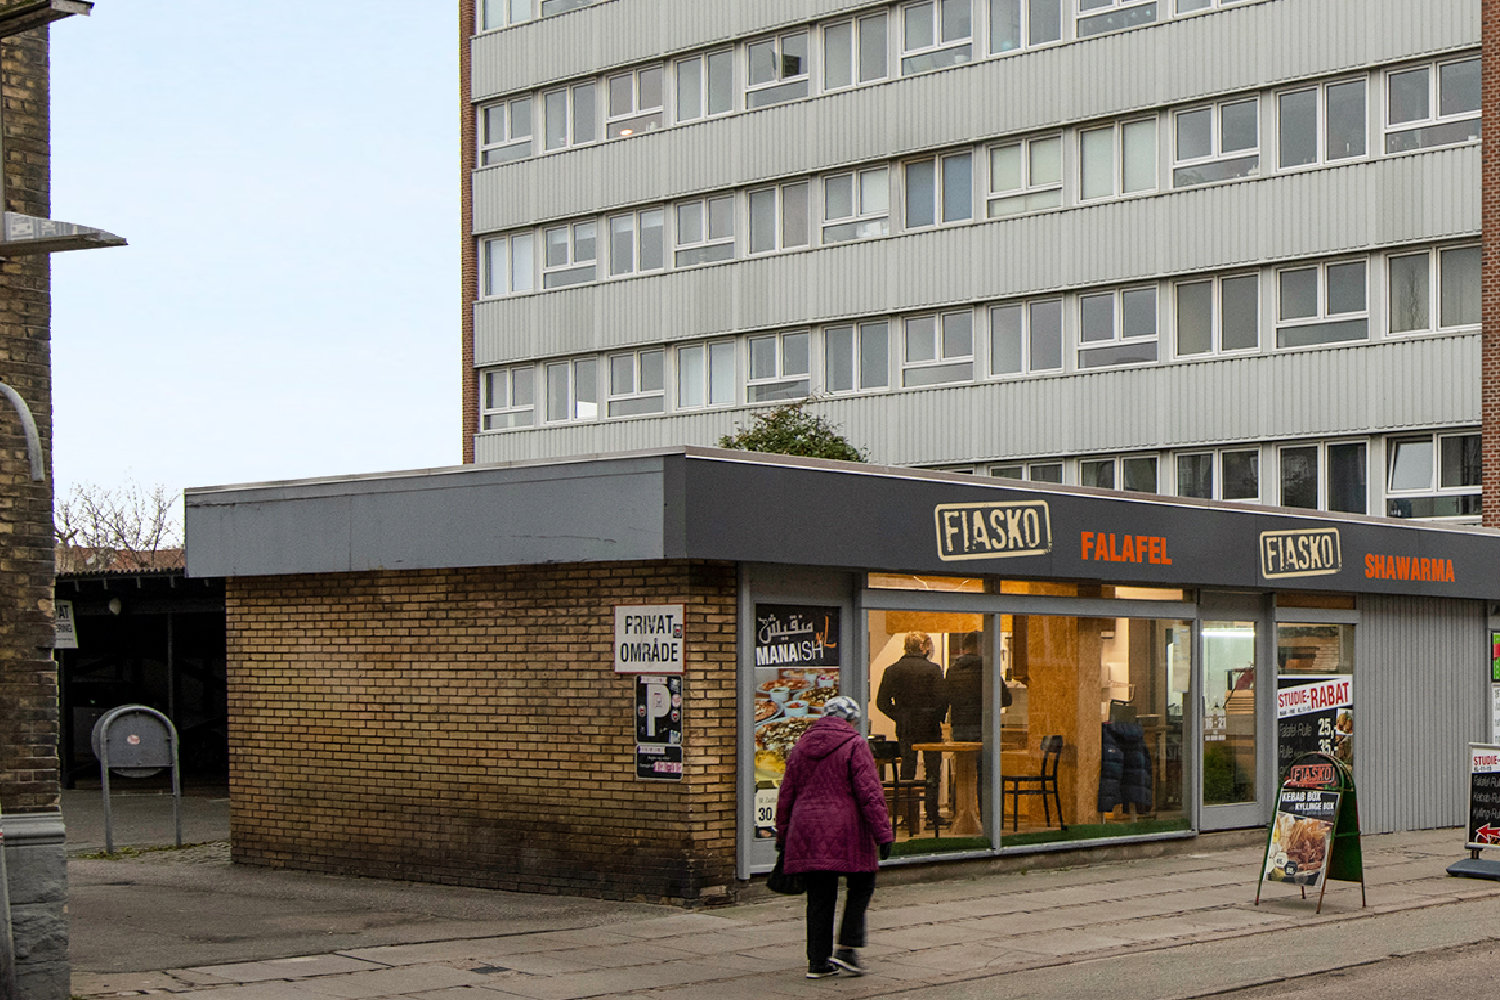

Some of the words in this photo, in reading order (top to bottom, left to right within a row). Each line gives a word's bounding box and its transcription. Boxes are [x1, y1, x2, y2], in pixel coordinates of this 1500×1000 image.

[944, 508, 1041, 552] FIASKO
[1081, 531, 1172, 565] FALAFEL
[1266, 535, 1334, 571] FIASKO
[1365, 553, 1455, 582] SHAWARMA
[624, 615, 674, 634] PRIVAT
[620, 637, 679, 662] OMRÅDE
[756, 640, 825, 666] MANAISH
